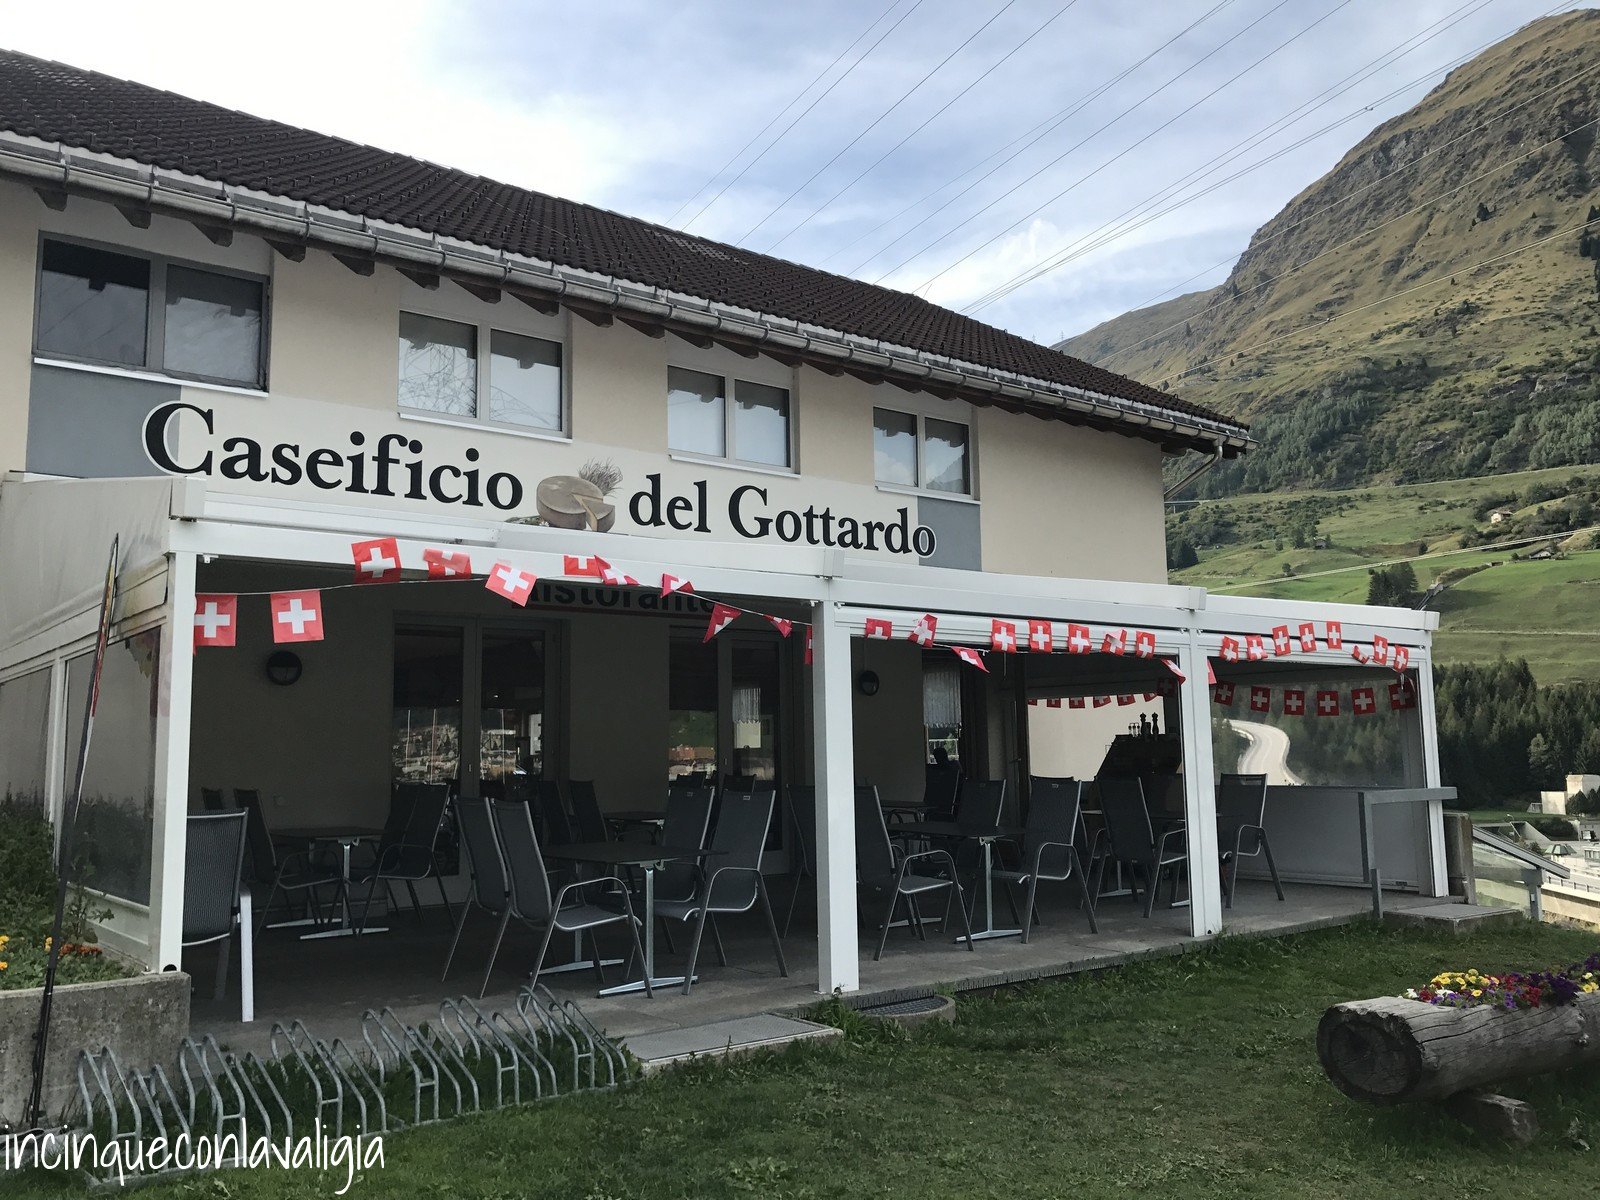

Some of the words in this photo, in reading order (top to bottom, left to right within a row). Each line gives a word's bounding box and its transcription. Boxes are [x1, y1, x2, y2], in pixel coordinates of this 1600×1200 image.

[144, 401, 523, 511] Caseificio
[629, 473, 712, 534] del
[728, 485, 936, 557] Gottardo
[530, 584, 715, 612] istorant
